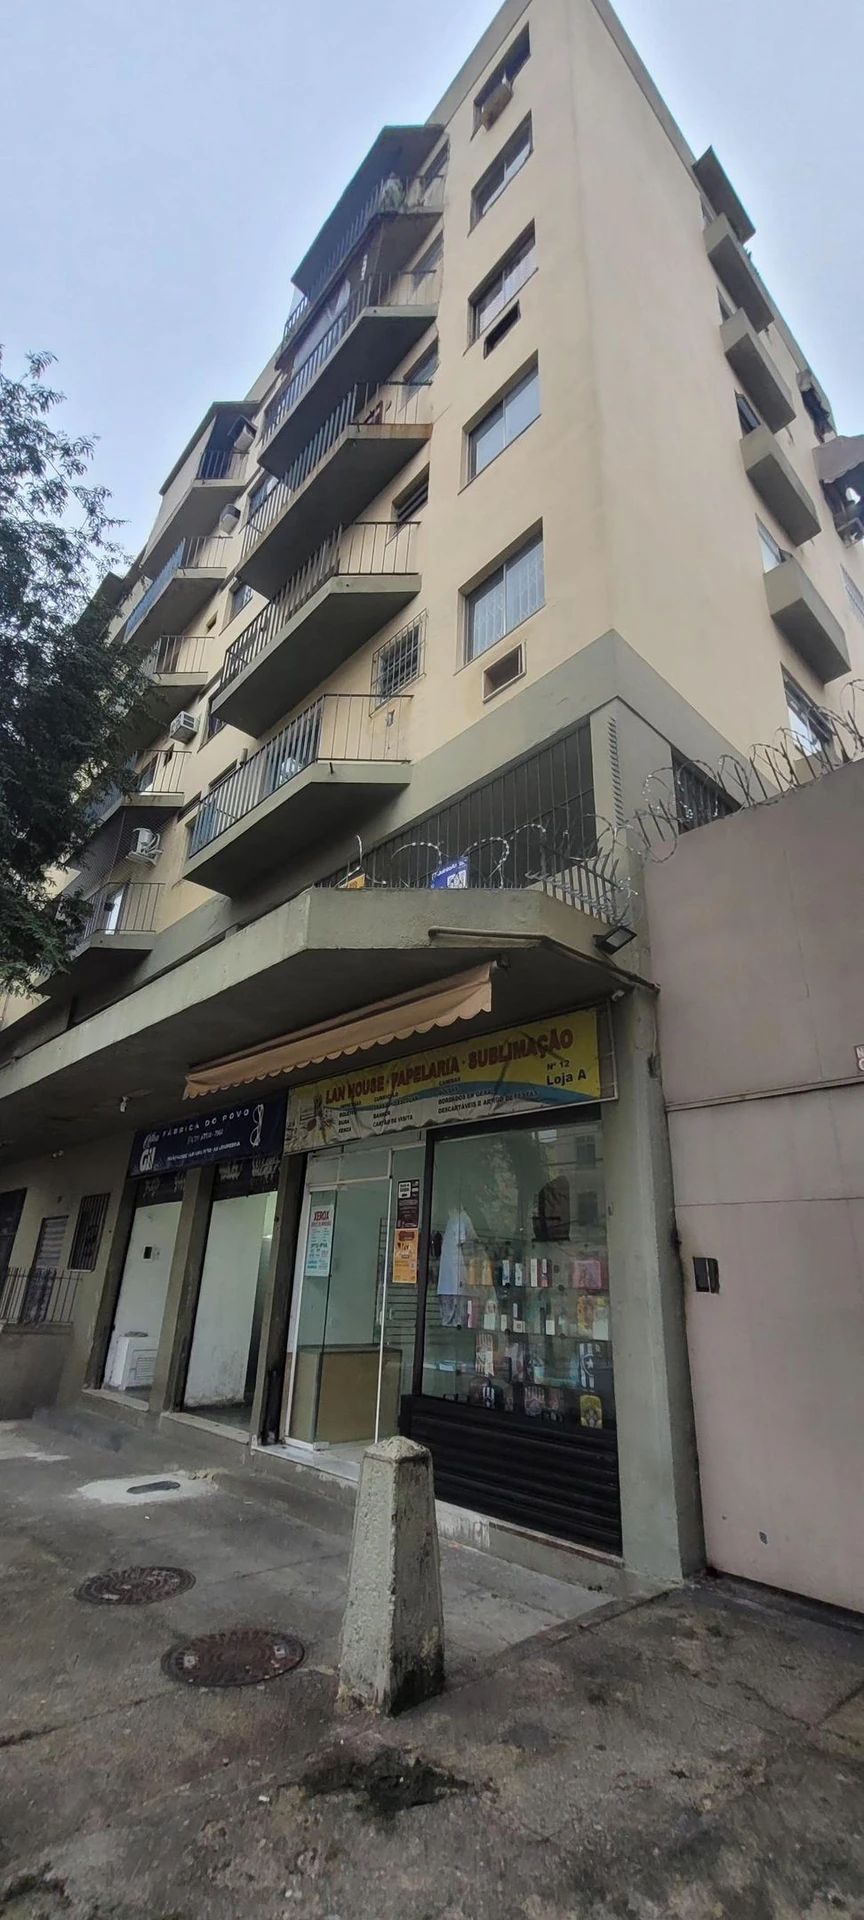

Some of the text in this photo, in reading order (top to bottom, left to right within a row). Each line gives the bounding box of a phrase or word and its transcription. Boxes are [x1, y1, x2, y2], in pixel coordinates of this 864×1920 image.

[326, 1028, 573, 1104] LAN HOUSE PAPELARIA SUBLIMAÇÃO
[559, 1059, 570, 1068] 12
[547, 1069, 587, 1087] Loja A
[204, 1117, 217, 1127] DO
[222, 1108, 250, 1121] POVO
[398, 1114, 413, 1122] VISITA
